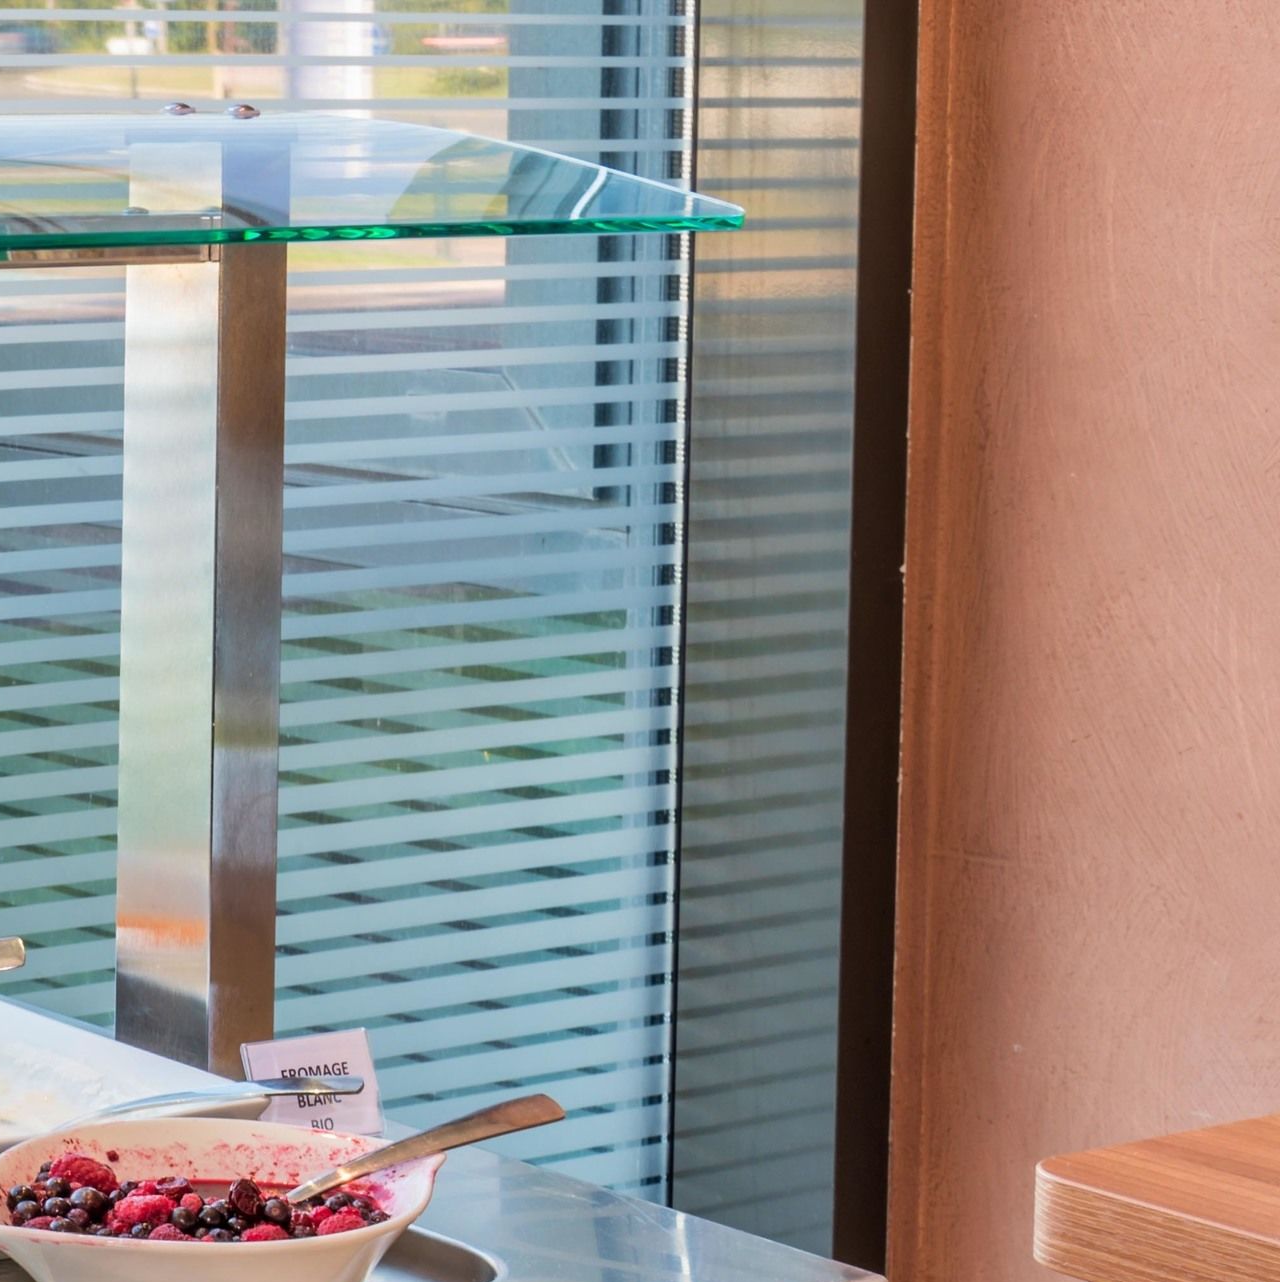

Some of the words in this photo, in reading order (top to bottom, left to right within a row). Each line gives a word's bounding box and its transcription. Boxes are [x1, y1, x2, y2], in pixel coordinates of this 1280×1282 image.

[280, 1061, 350, 1079] FROMAGE
[296, 1092, 343, 1109] BLANC
[310, 1116, 335, 1131] BIO
